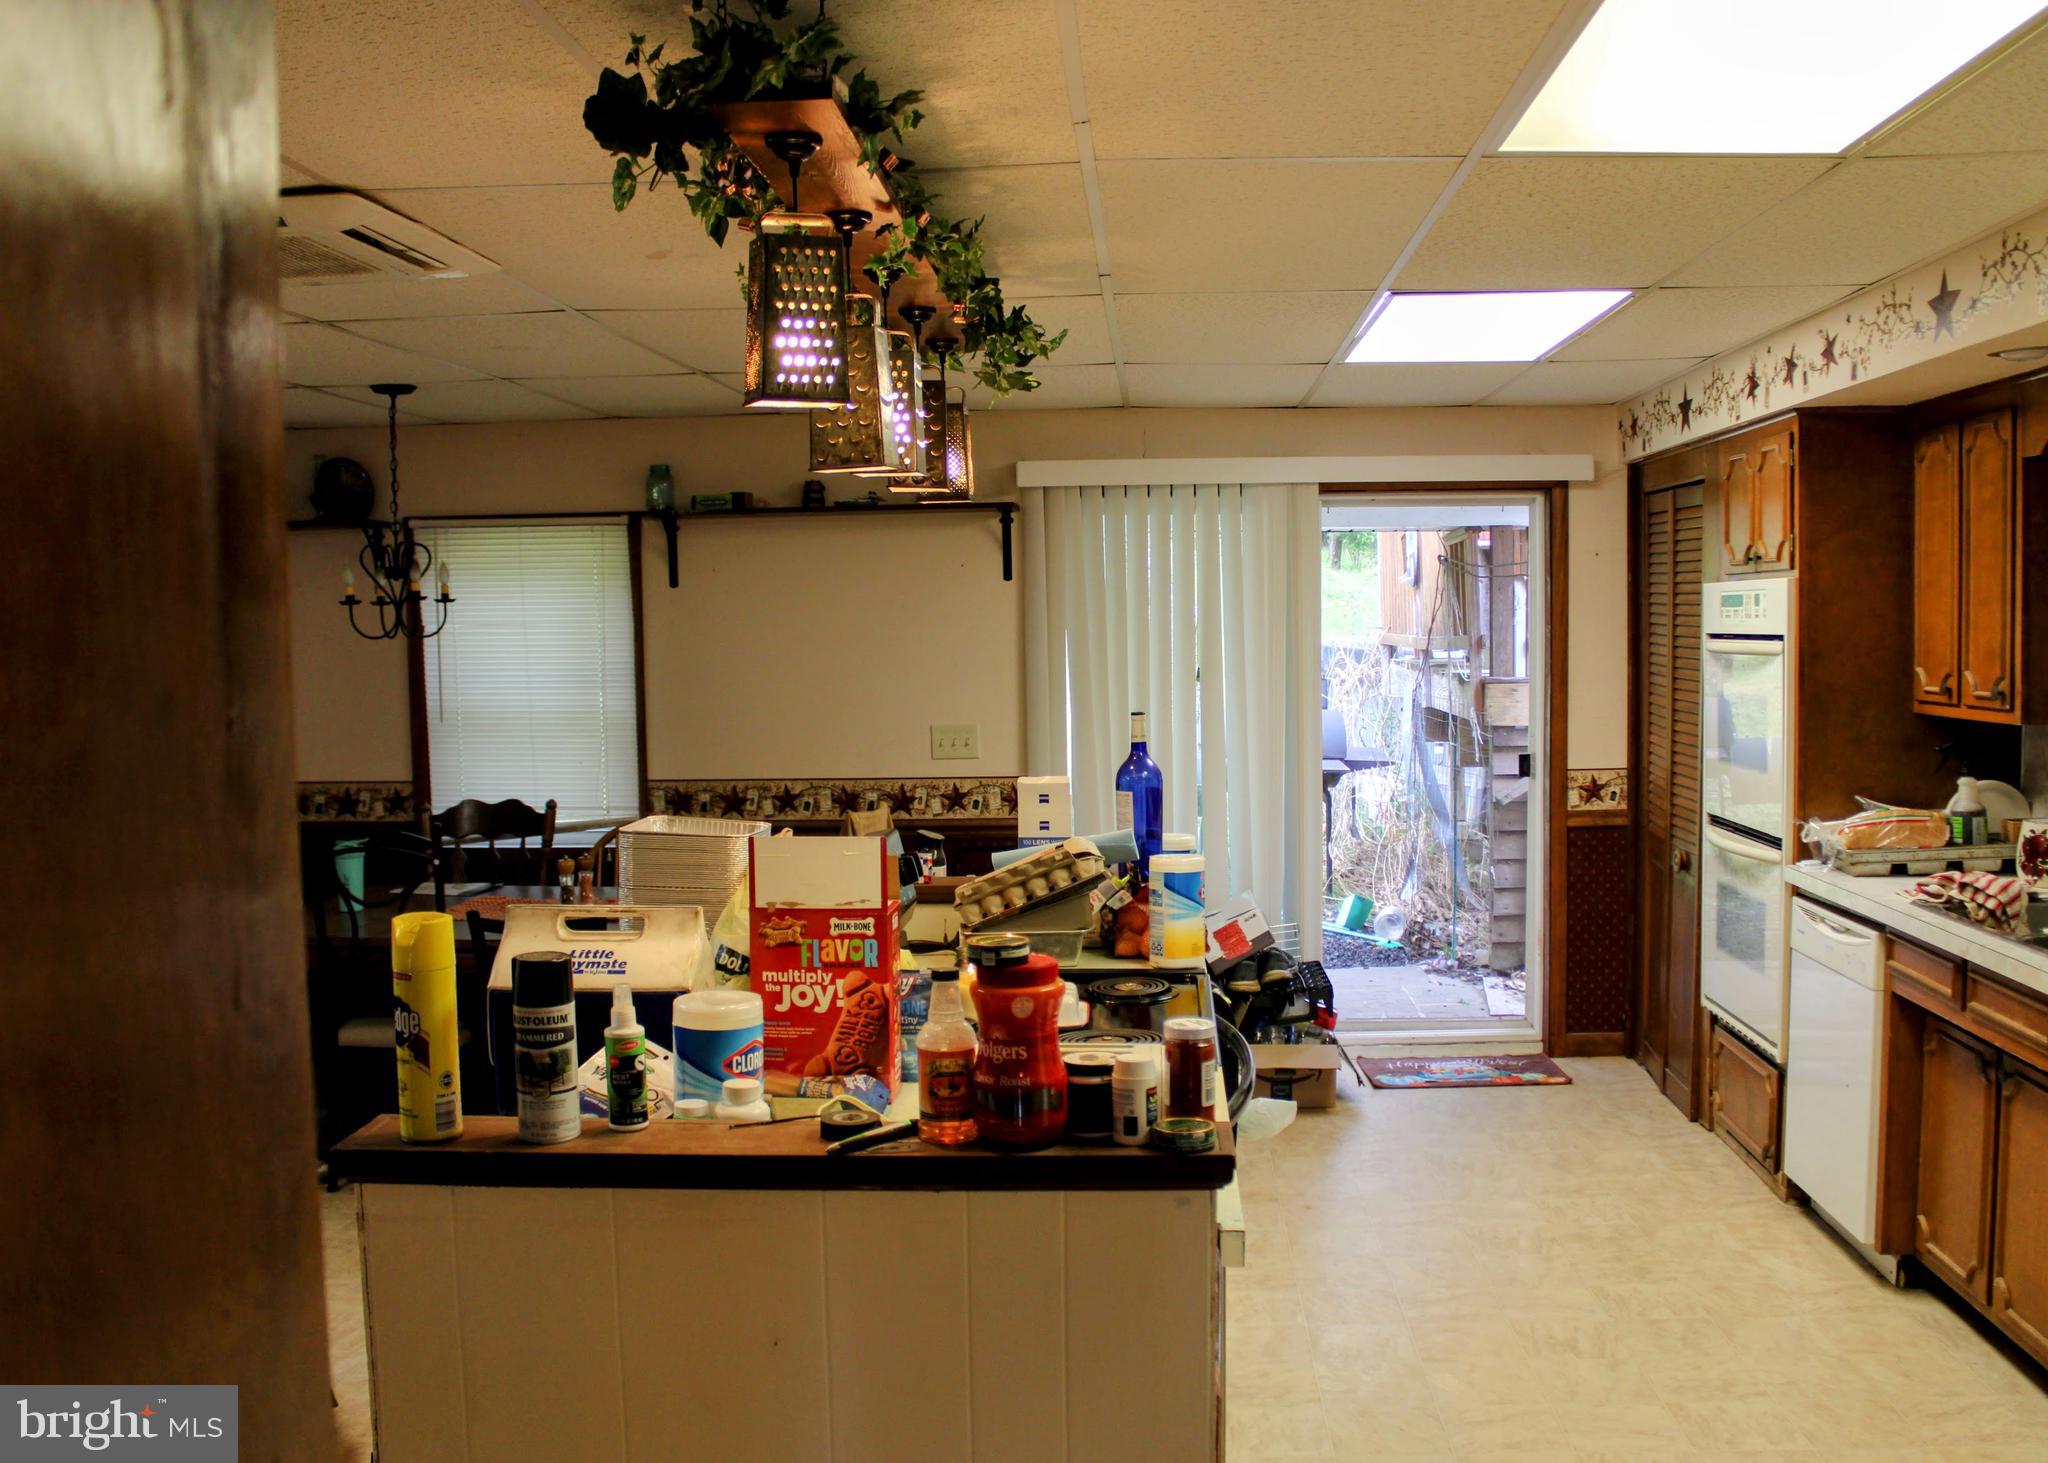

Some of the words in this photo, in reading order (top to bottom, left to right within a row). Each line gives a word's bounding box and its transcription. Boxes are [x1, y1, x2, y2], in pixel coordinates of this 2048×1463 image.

[570, 949, 614, 959] Little
[572, 960, 628, 970] ymate
[762, 969, 832, 985] multiply
[765, 983, 780, 991] the
[901, 1000, 927, 1015] ONE
[395, 1006, 420, 1038] dge
[835, 1009, 863, 1047] MILK
[732, 1049, 763, 1074] CLOR
